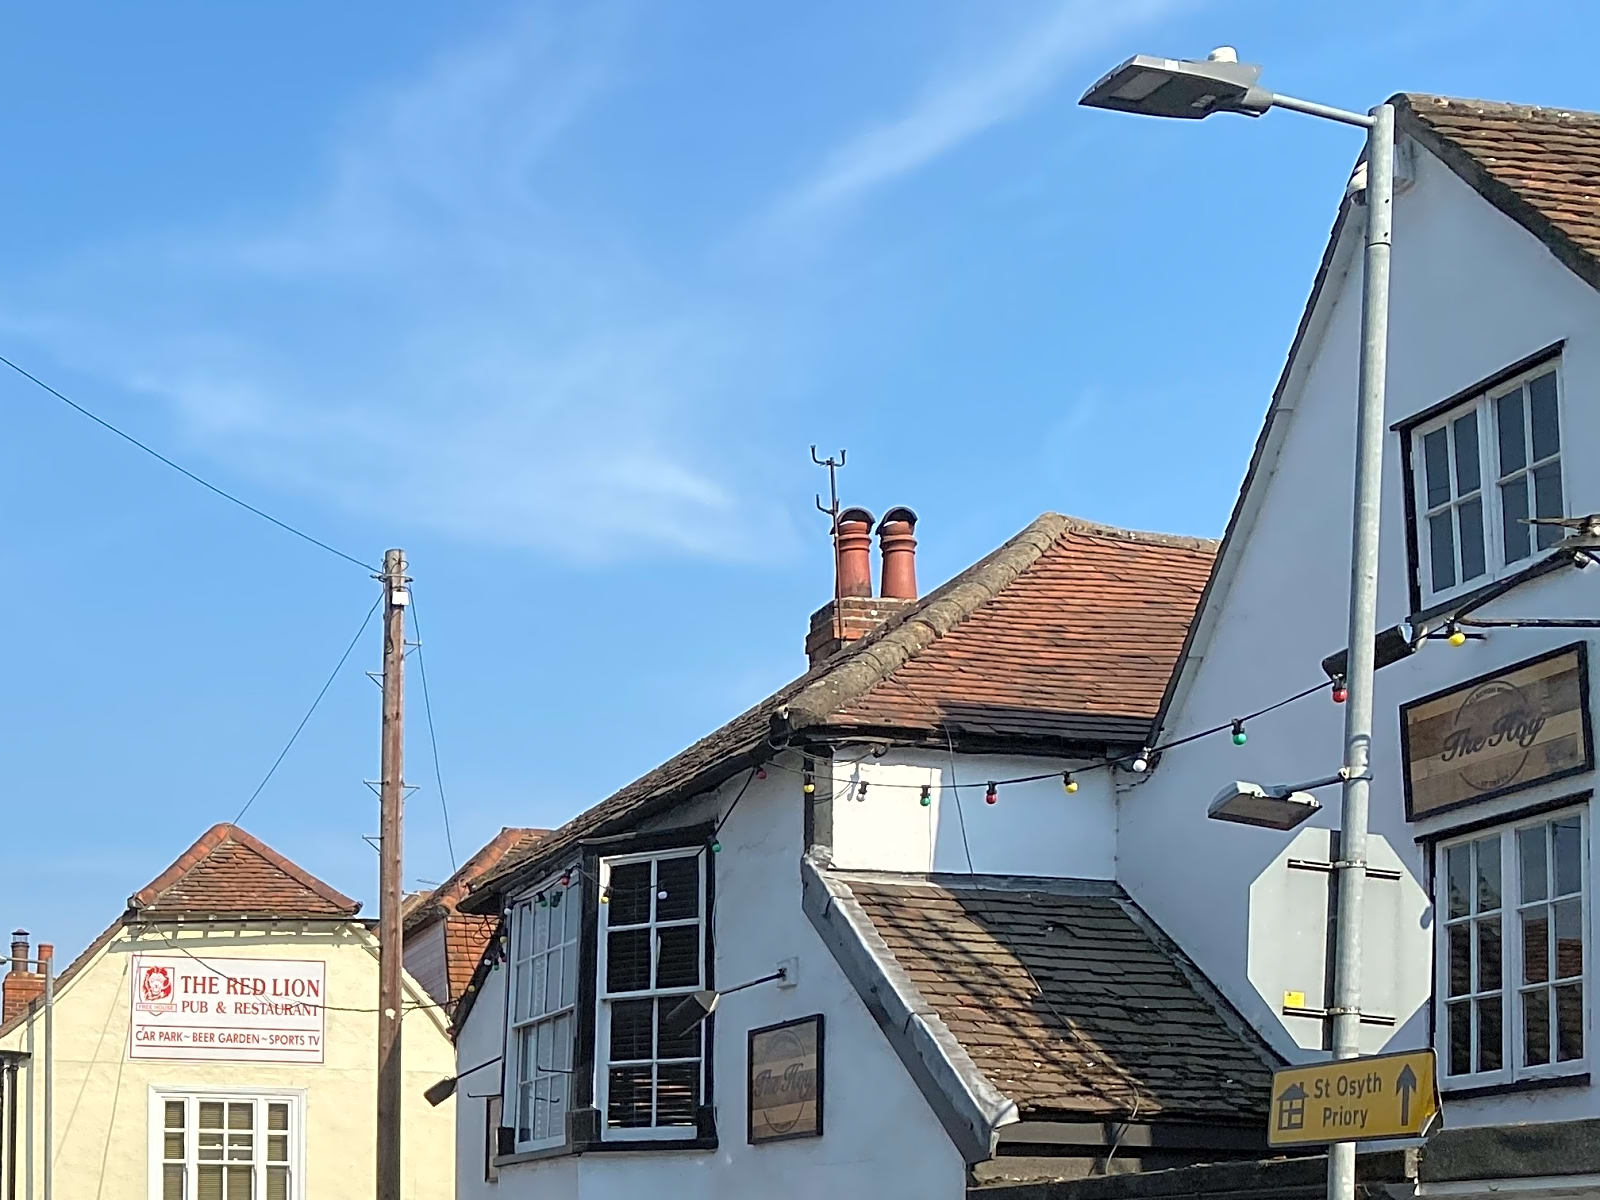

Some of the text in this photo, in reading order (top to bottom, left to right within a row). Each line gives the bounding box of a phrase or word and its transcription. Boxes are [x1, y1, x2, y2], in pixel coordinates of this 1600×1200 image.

[1441, 727, 1486, 762] The
[180, 975, 320, 998] THE RED LION
[181, 1000, 319, 1017] PUB & RESTAURANT
[135, 1030, 320, 1046] CAR PARK BEER GARDEN SPORTS TV
[1313, 1071, 1382, 1100] St Osyth
[1322, 1105, 1369, 1129] Priory
